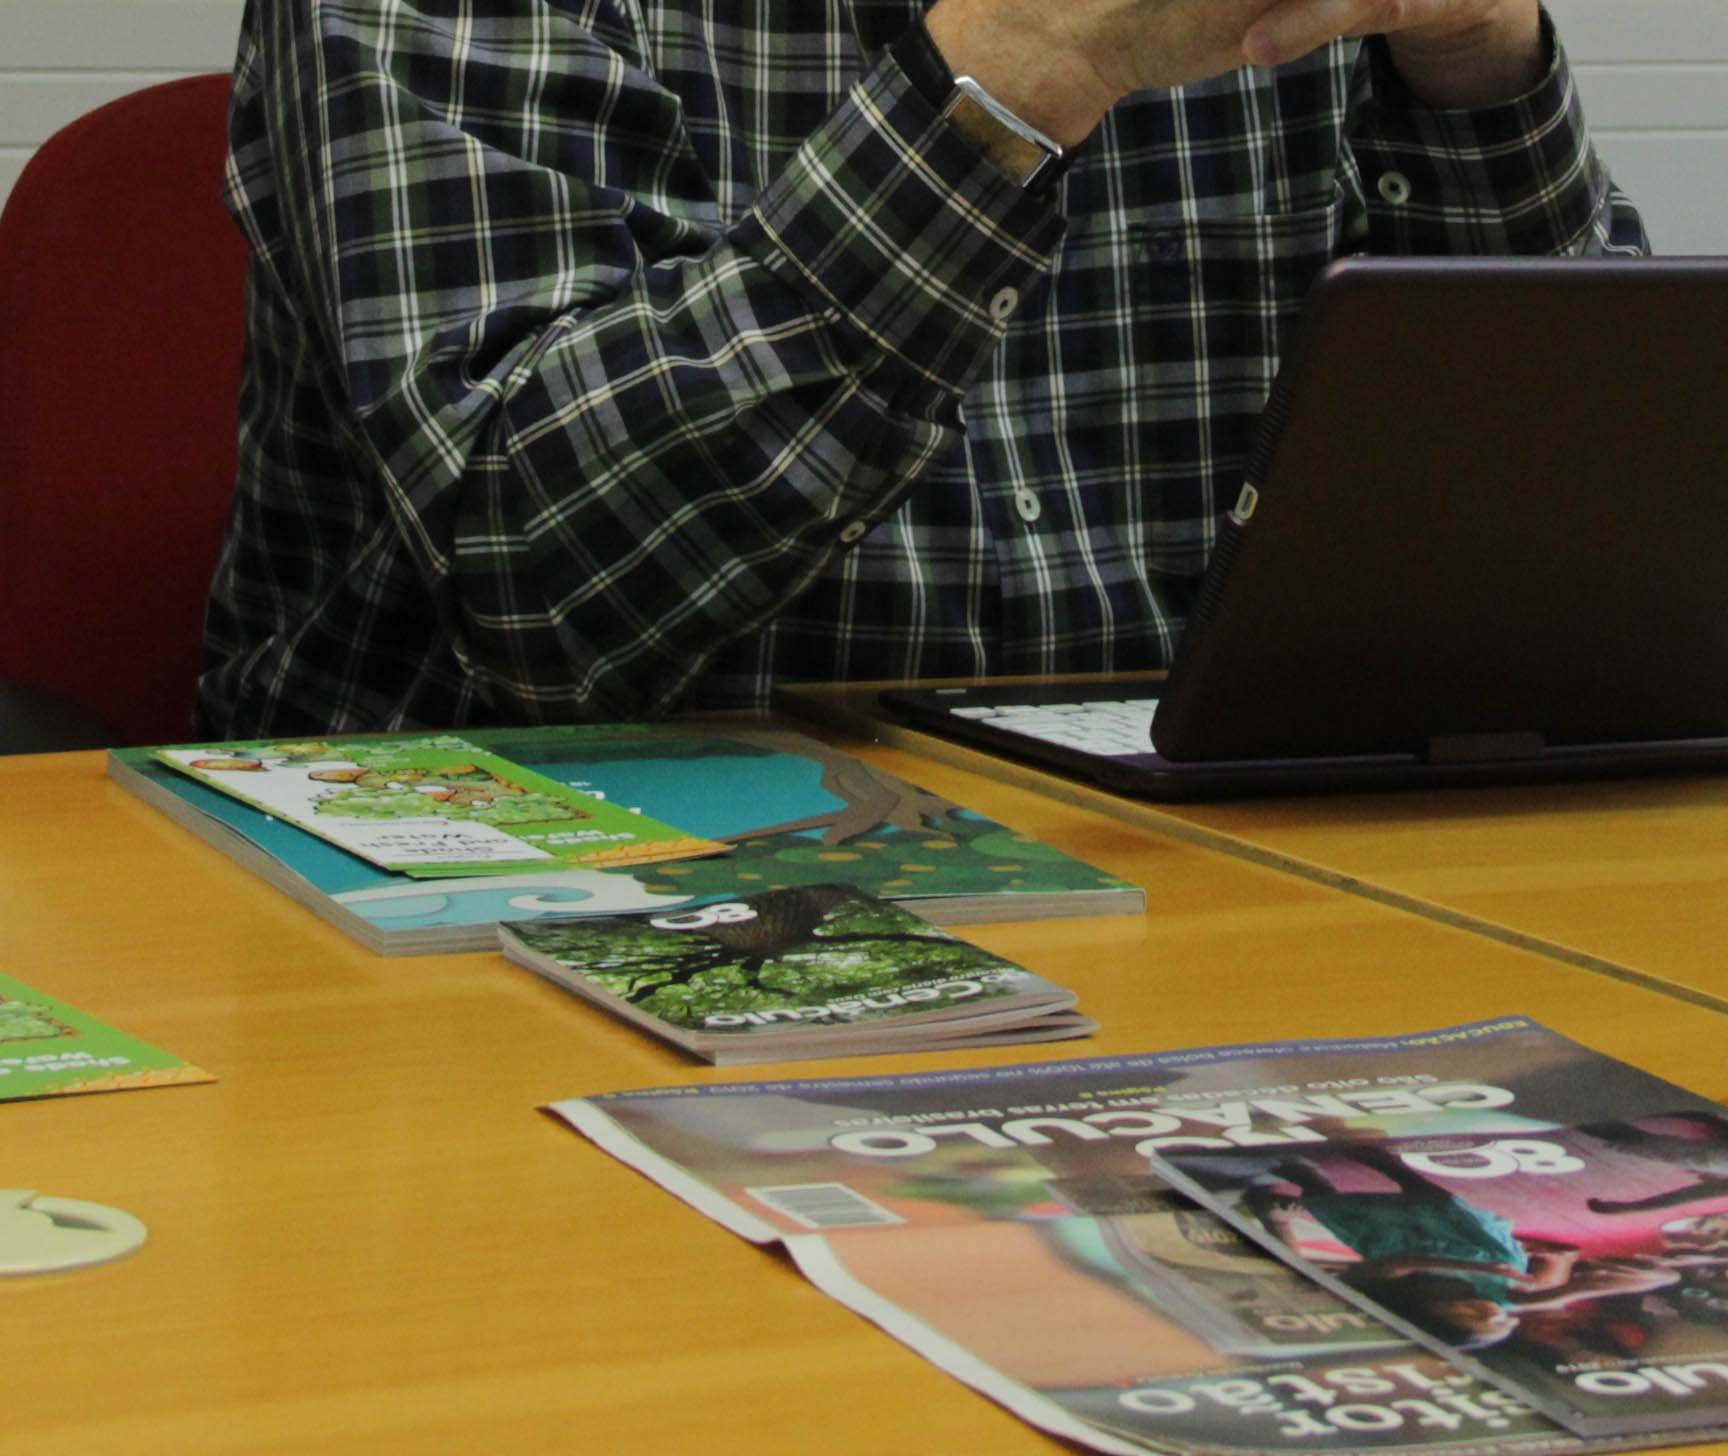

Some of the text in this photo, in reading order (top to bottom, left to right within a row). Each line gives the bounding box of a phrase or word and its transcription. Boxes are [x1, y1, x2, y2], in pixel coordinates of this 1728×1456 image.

[649, 903, 758, 931] 80
[703, 980, 983, 1028] Cenáculo
[23, 1056, 132, 1072] Shade
[1006, 1101, 1104, 1115] terras
[1107, 1096, 1159, 1107] em
[830, 1084, 1515, 1157] CENÁCULO
[833, 1109, 1005, 1128] brasileiras
[1400, 1139, 1586, 1178] 80
